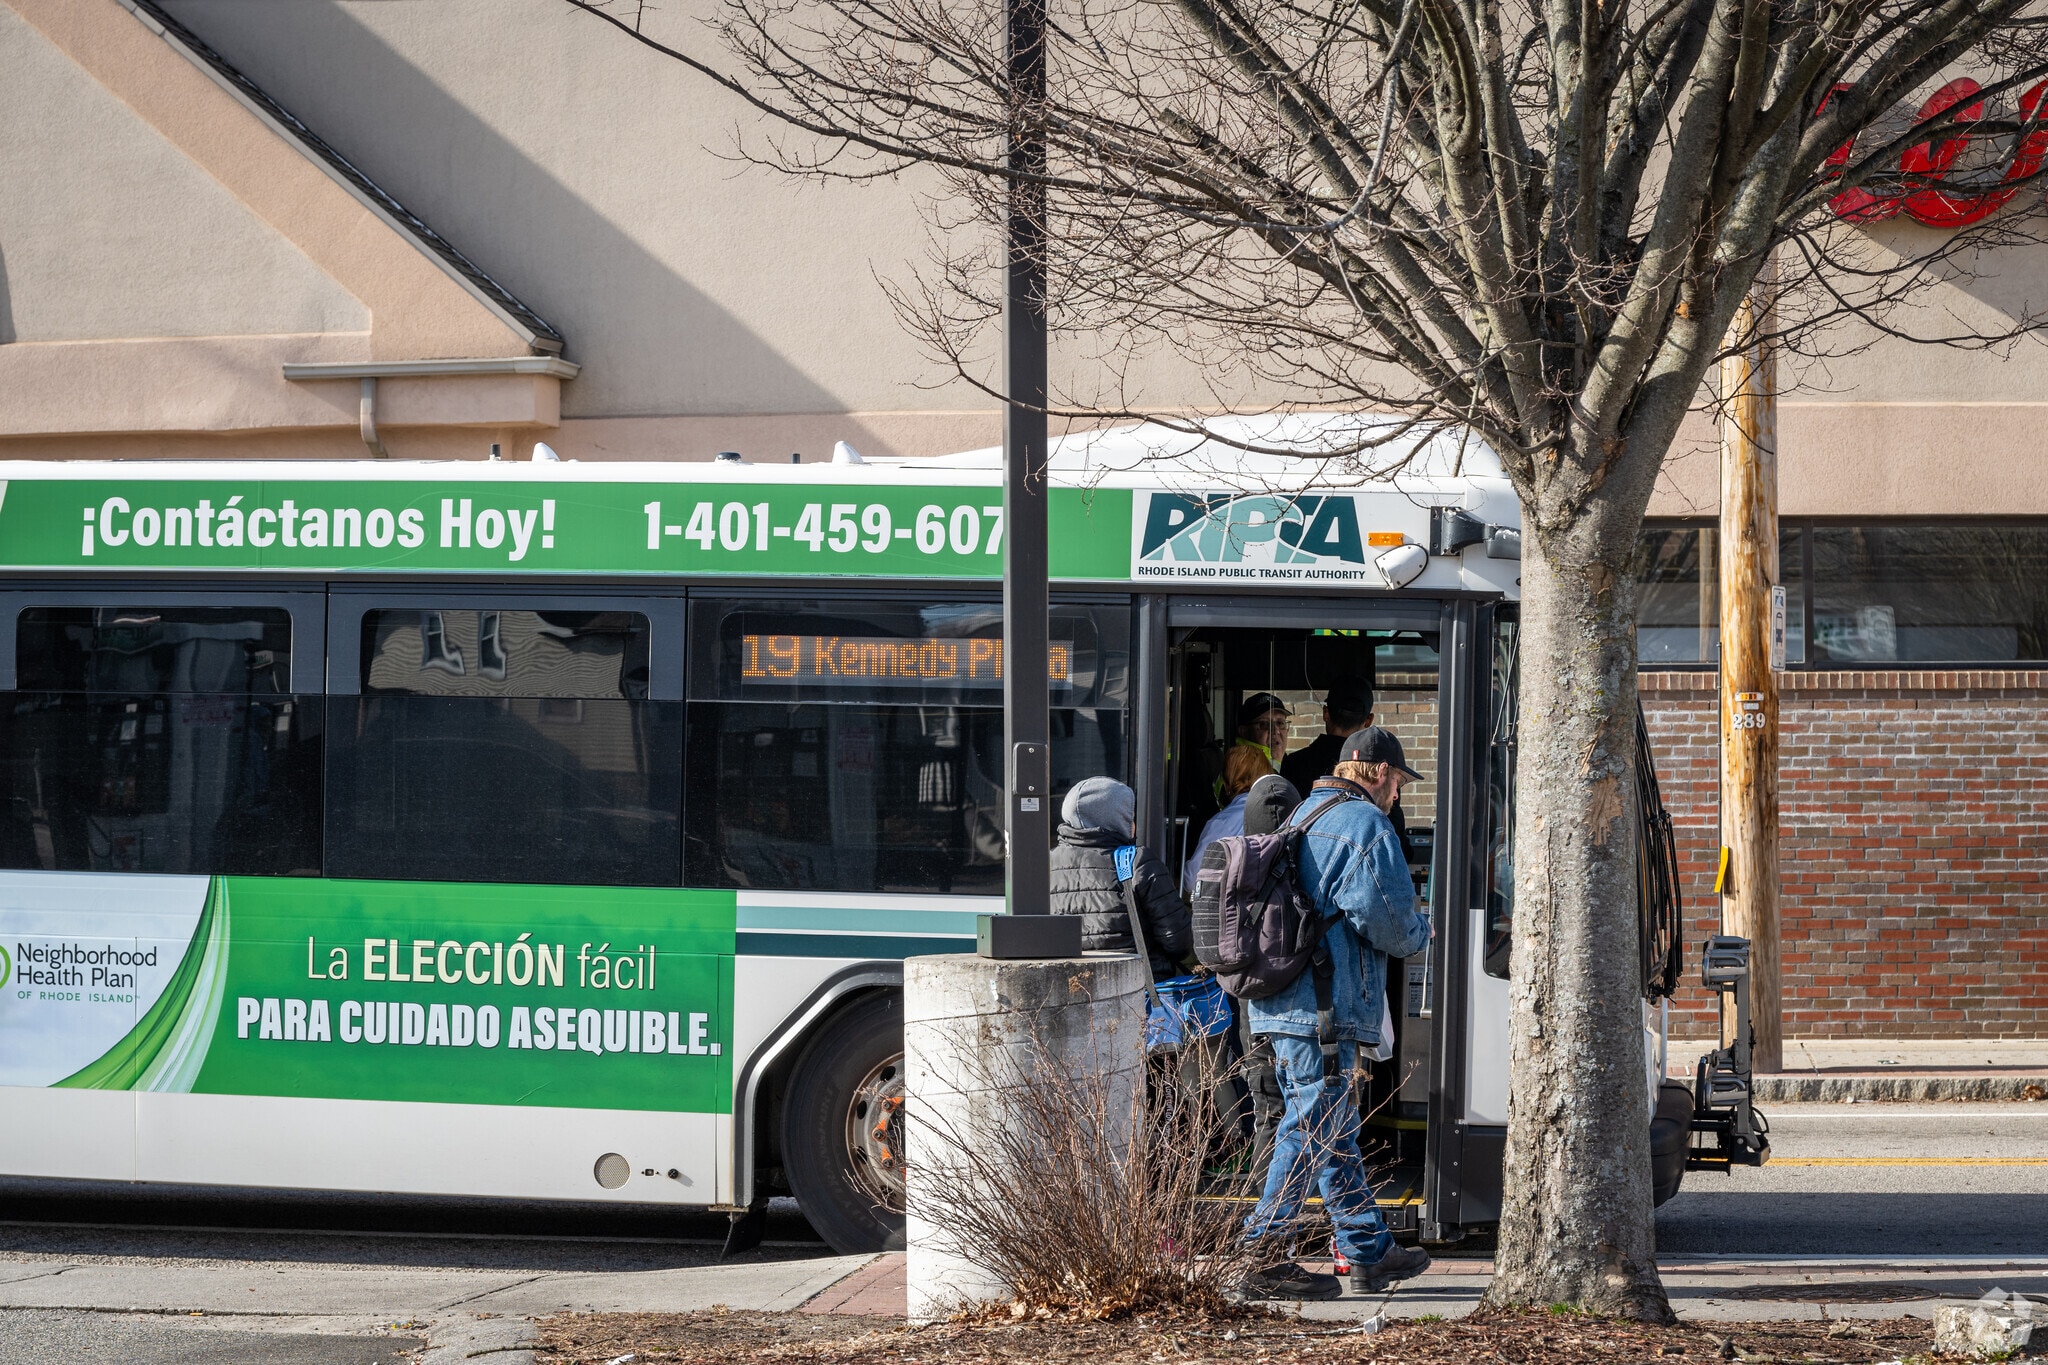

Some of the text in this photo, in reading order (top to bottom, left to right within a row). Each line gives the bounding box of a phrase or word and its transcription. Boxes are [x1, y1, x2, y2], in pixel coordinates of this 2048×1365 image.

[81, 495, 556, 562] ¡Contáctanos Hoy!
[643, 501, 1005, 555] 1-401-459-607
[1138, 566, 1366, 580] RHODE ISLAND PUBLIC TRANSIT AUTHORITY
[743, 634, 1068, 680] 19 Kennedy Pla
[1732, 712, 1766, 730] 289
[17, 942, 157, 969] Neighborhood
[307, 932, 656, 991] La ELECCIÓN fácil
[17, 964, 134, 988] Health Plan
[17, 990, 32, 1000] OF
[39, 991, 81, 1001] RHODE
[237, 996, 723, 1058] PARA CUIDADO ASEQUIBLE.
